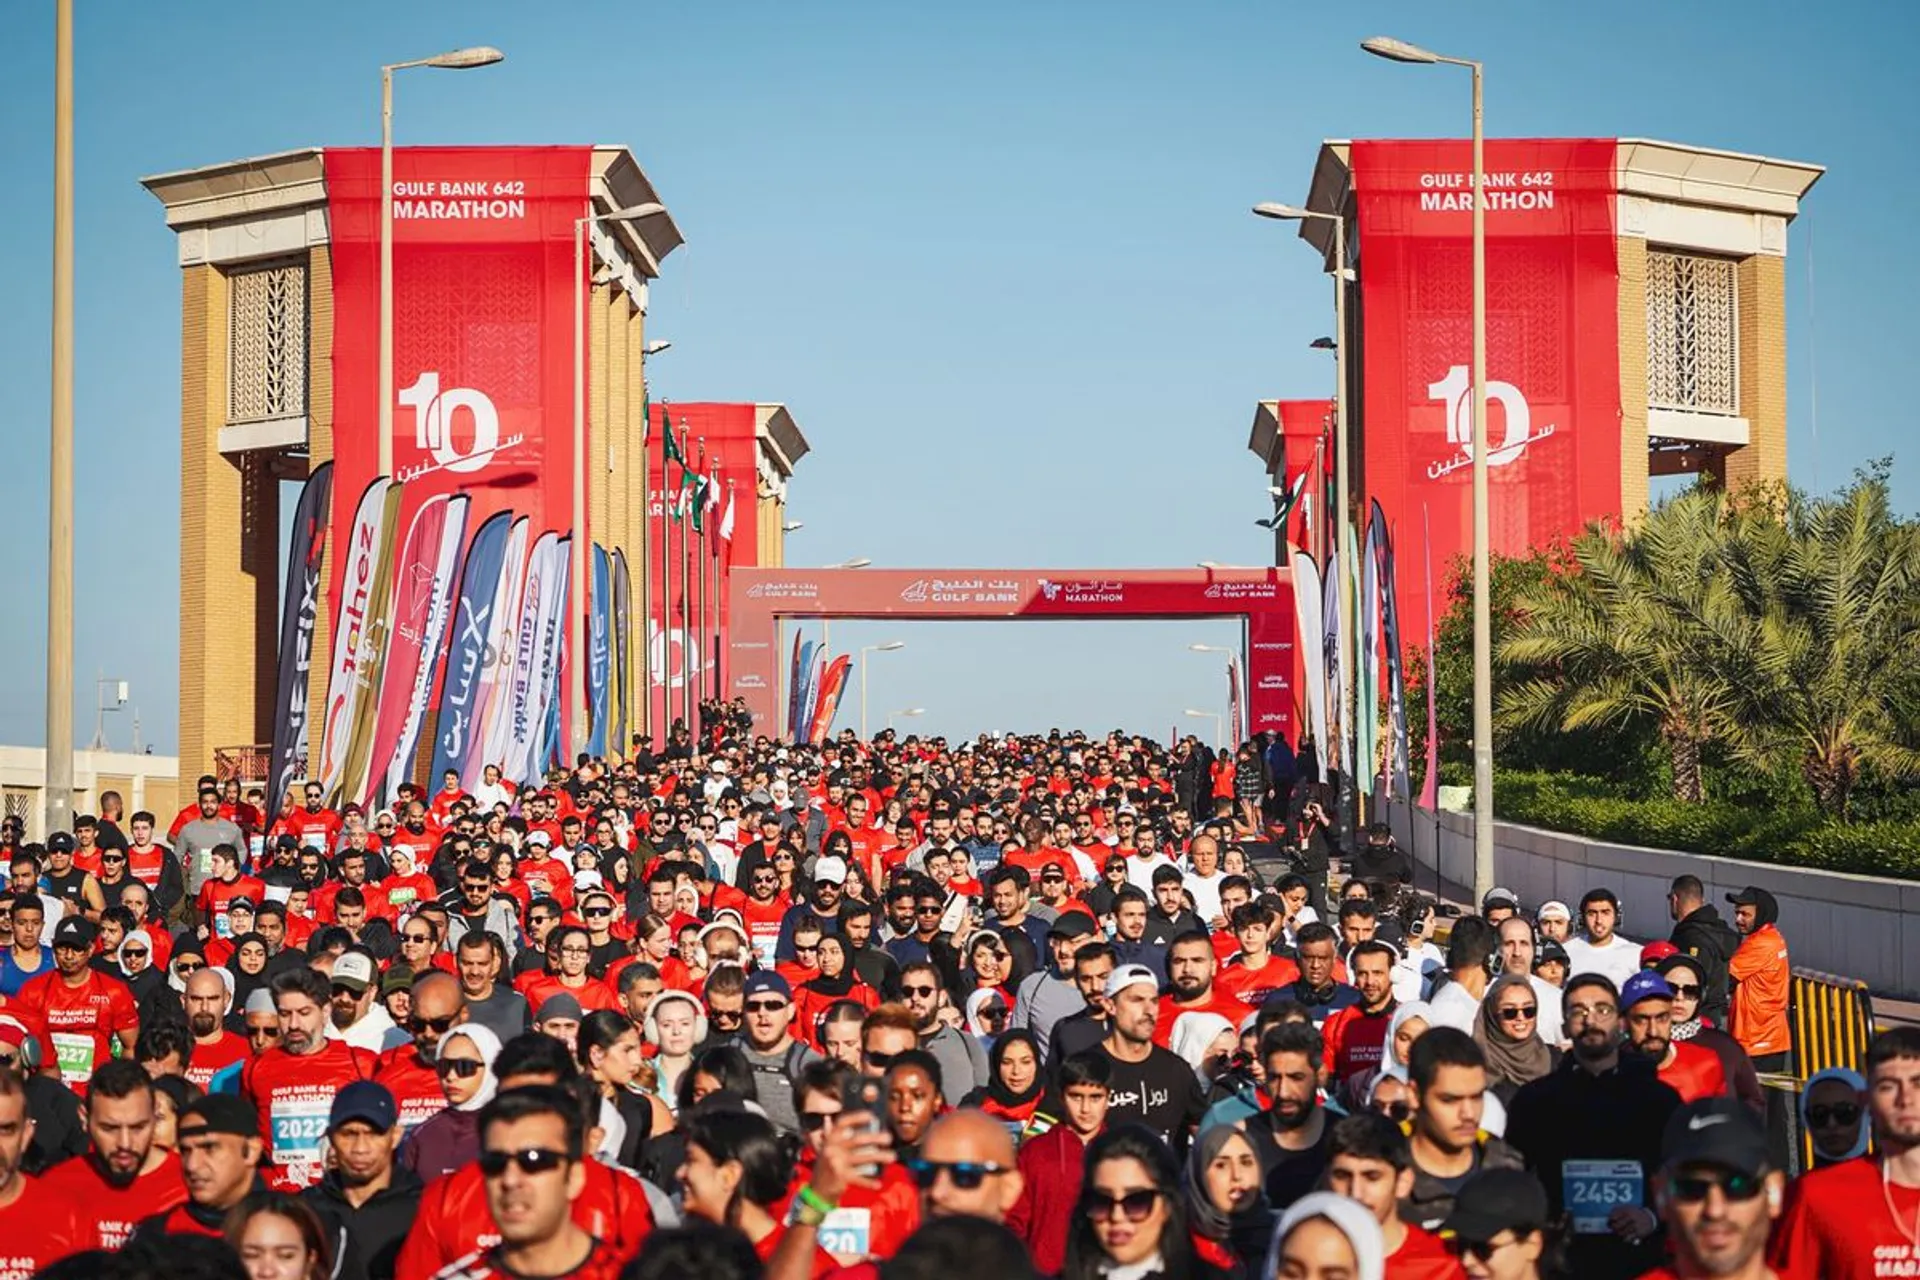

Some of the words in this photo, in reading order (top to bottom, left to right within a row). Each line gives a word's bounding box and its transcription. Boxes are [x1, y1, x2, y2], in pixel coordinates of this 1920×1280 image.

[1420, 174, 1463, 188] GULF
[1521, 172, 1553, 186] 642
[393, 182, 435, 196] GULF
[440, 182, 488, 196] BANK
[493, 181, 525, 196] 642
[1421, 191, 1554, 211] MARATHON
[393, 200, 525, 219] MARATHON
[398, 371, 499, 473] 10
[1428, 365, 1530, 466] 10
[932, 592, 969, 602] GULF
[974, 592, 1018, 602] BANK
[1065, 593, 1123, 602] MARATHON
[48, 1016, 97, 1025] MARATHON
[272, 1086, 292, 1096] GULF
[294, 1084, 317, 1094] BANK
[1573, 1181, 1633, 1204] 2453
